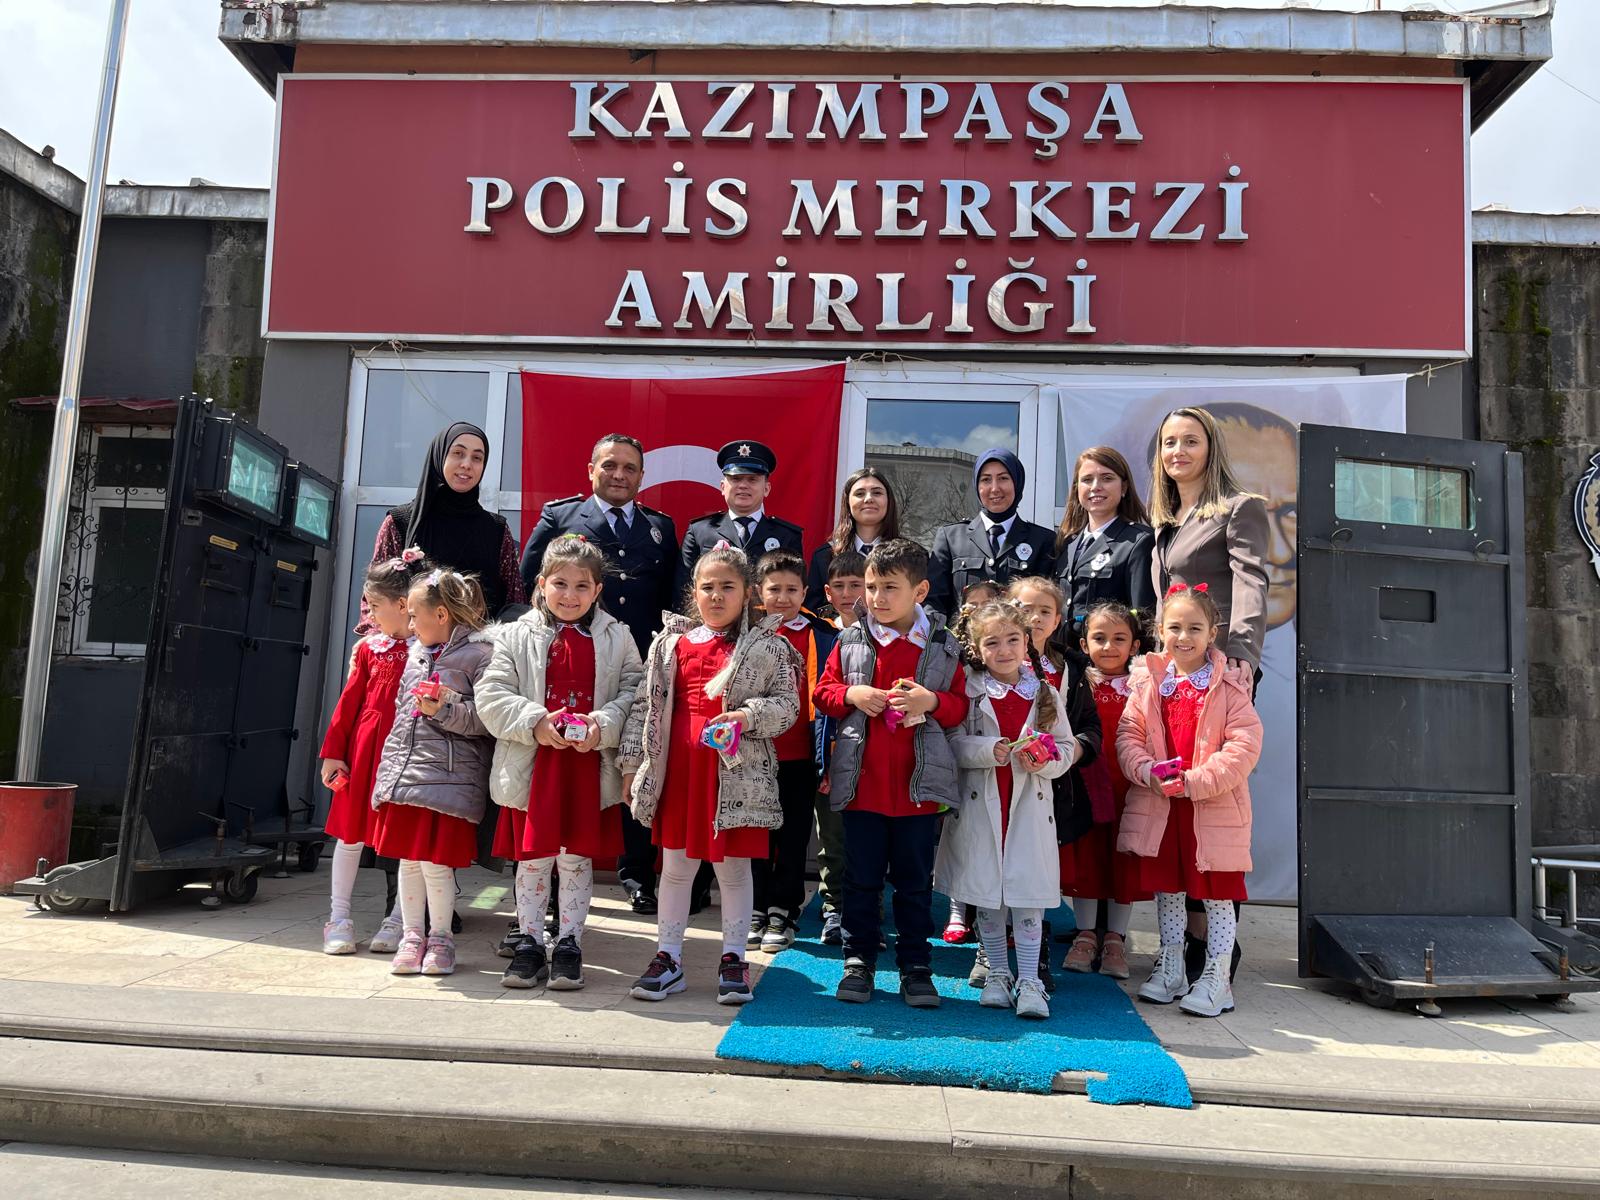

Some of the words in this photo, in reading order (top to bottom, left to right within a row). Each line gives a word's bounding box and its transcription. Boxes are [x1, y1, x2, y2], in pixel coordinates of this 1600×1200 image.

[568, 81, 1144, 159] KAZIMPAŞA
[463, 161, 749, 238] POLİS
[782, 165, 1250, 243] MERKEZİ
[605, 255, 1098, 336] AMİRLİĞİ
